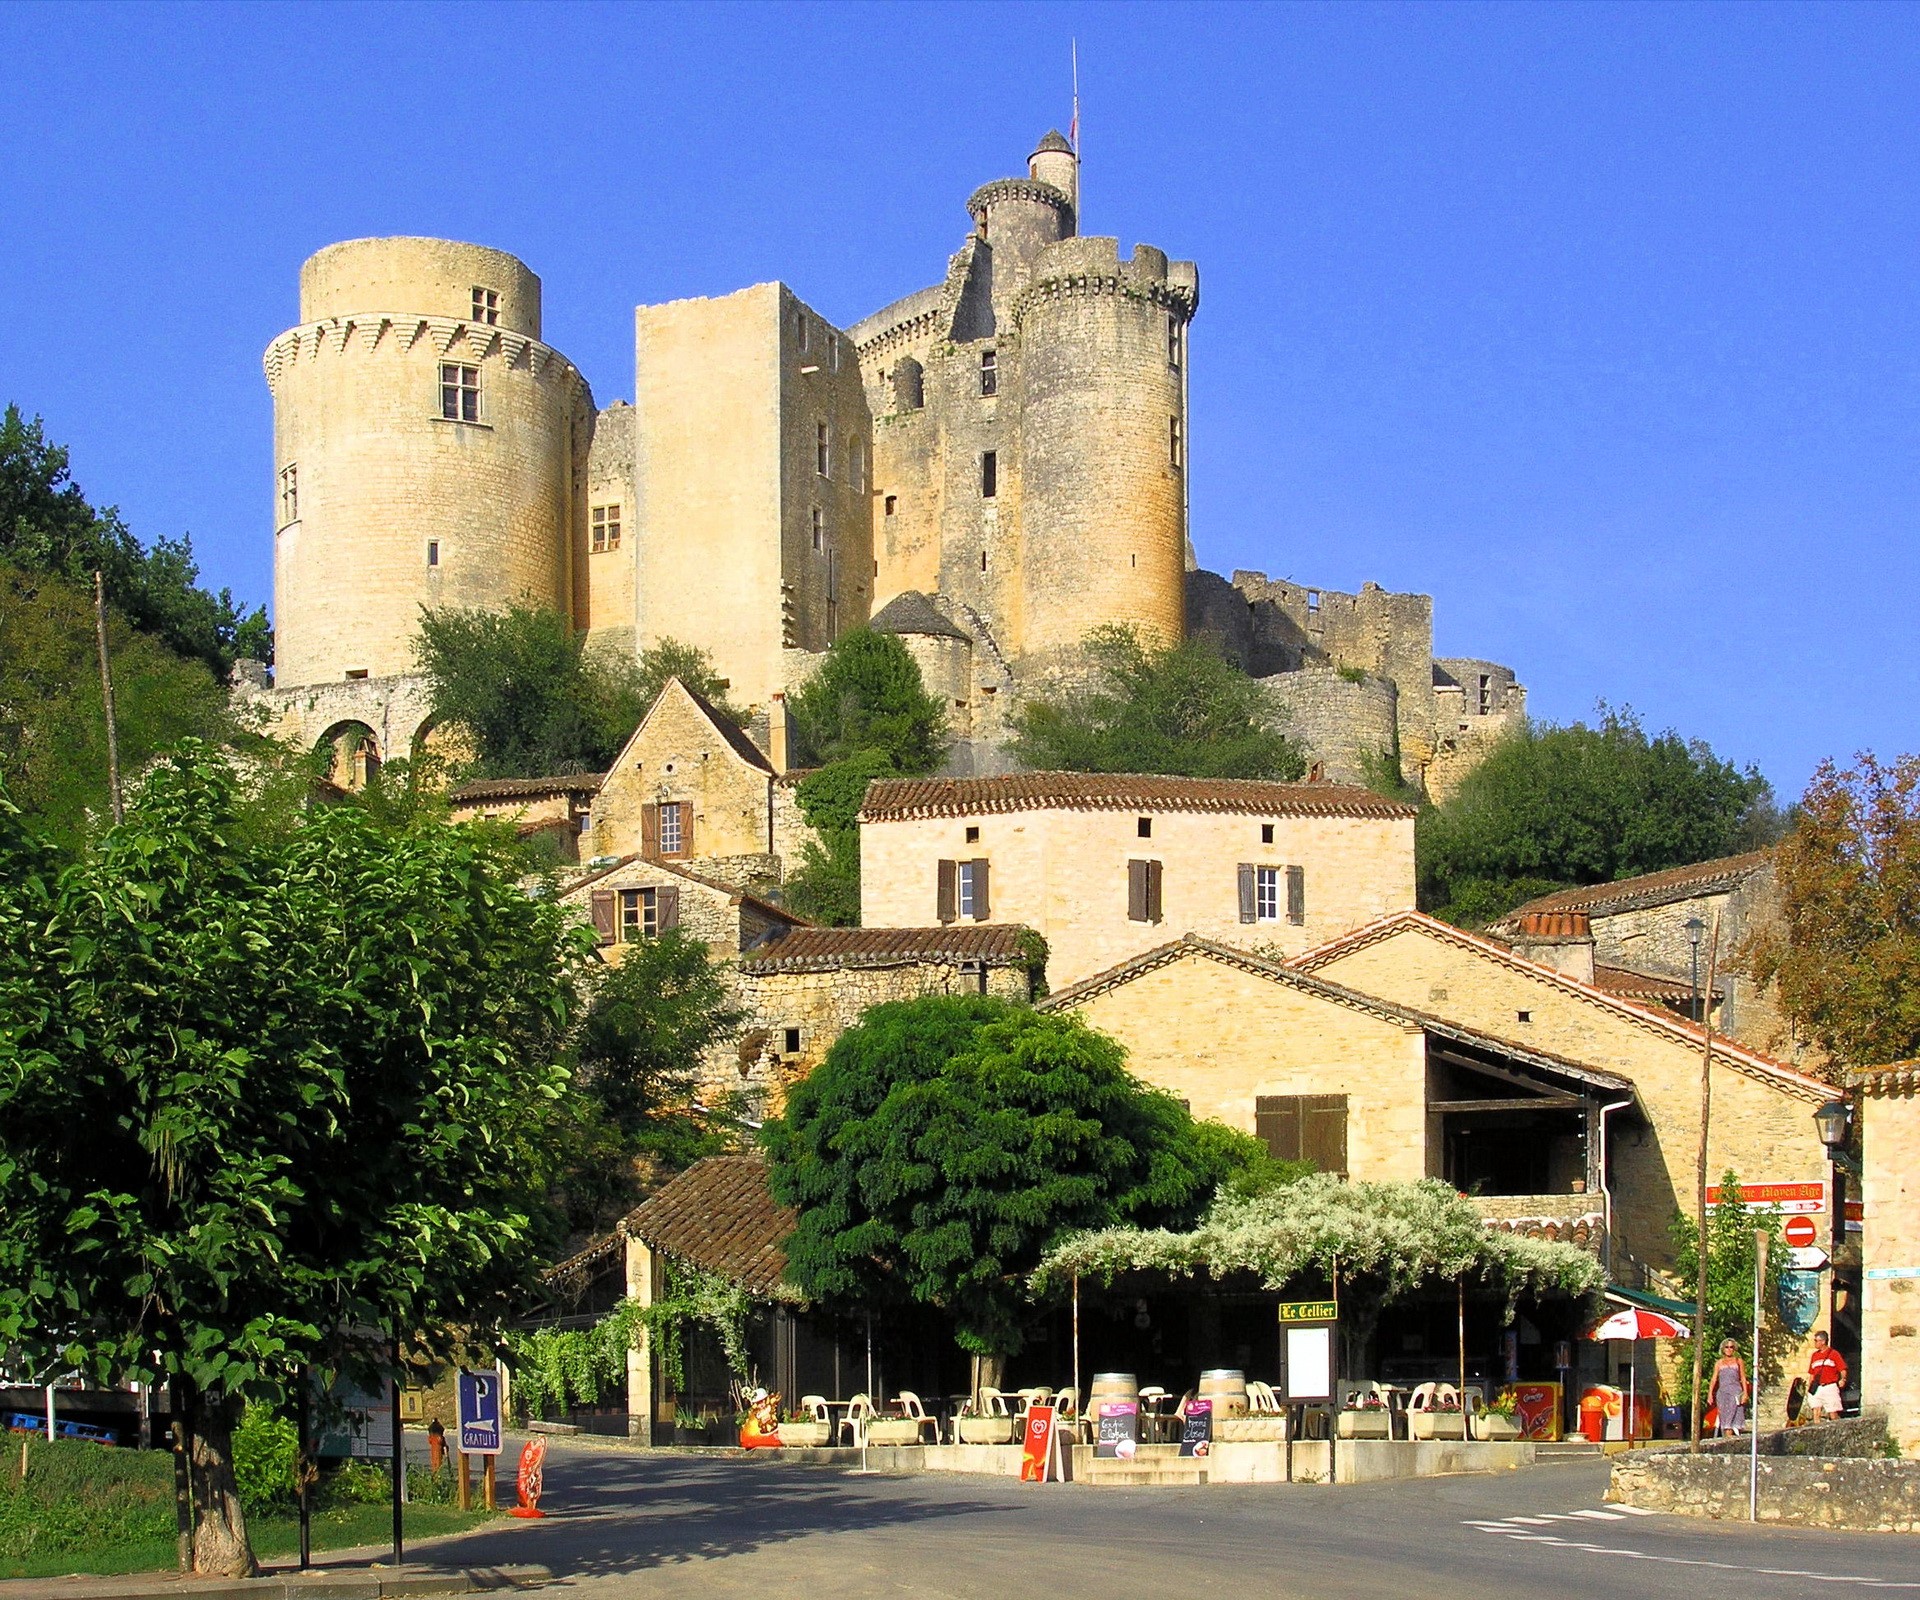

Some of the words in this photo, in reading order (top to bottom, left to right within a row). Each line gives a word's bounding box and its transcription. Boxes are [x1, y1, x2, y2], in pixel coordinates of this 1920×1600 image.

[1761, 1186, 1796, 1201] Moyen
[1800, 1185, 1820, 1199] Age
[1282, 1305, 1296, 1318] Le
[1298, 1304, 1334, 1318] Cellier
[475, 1377, 489, 1419] P
[463, 1433, 497, 1447] GRATUIT
